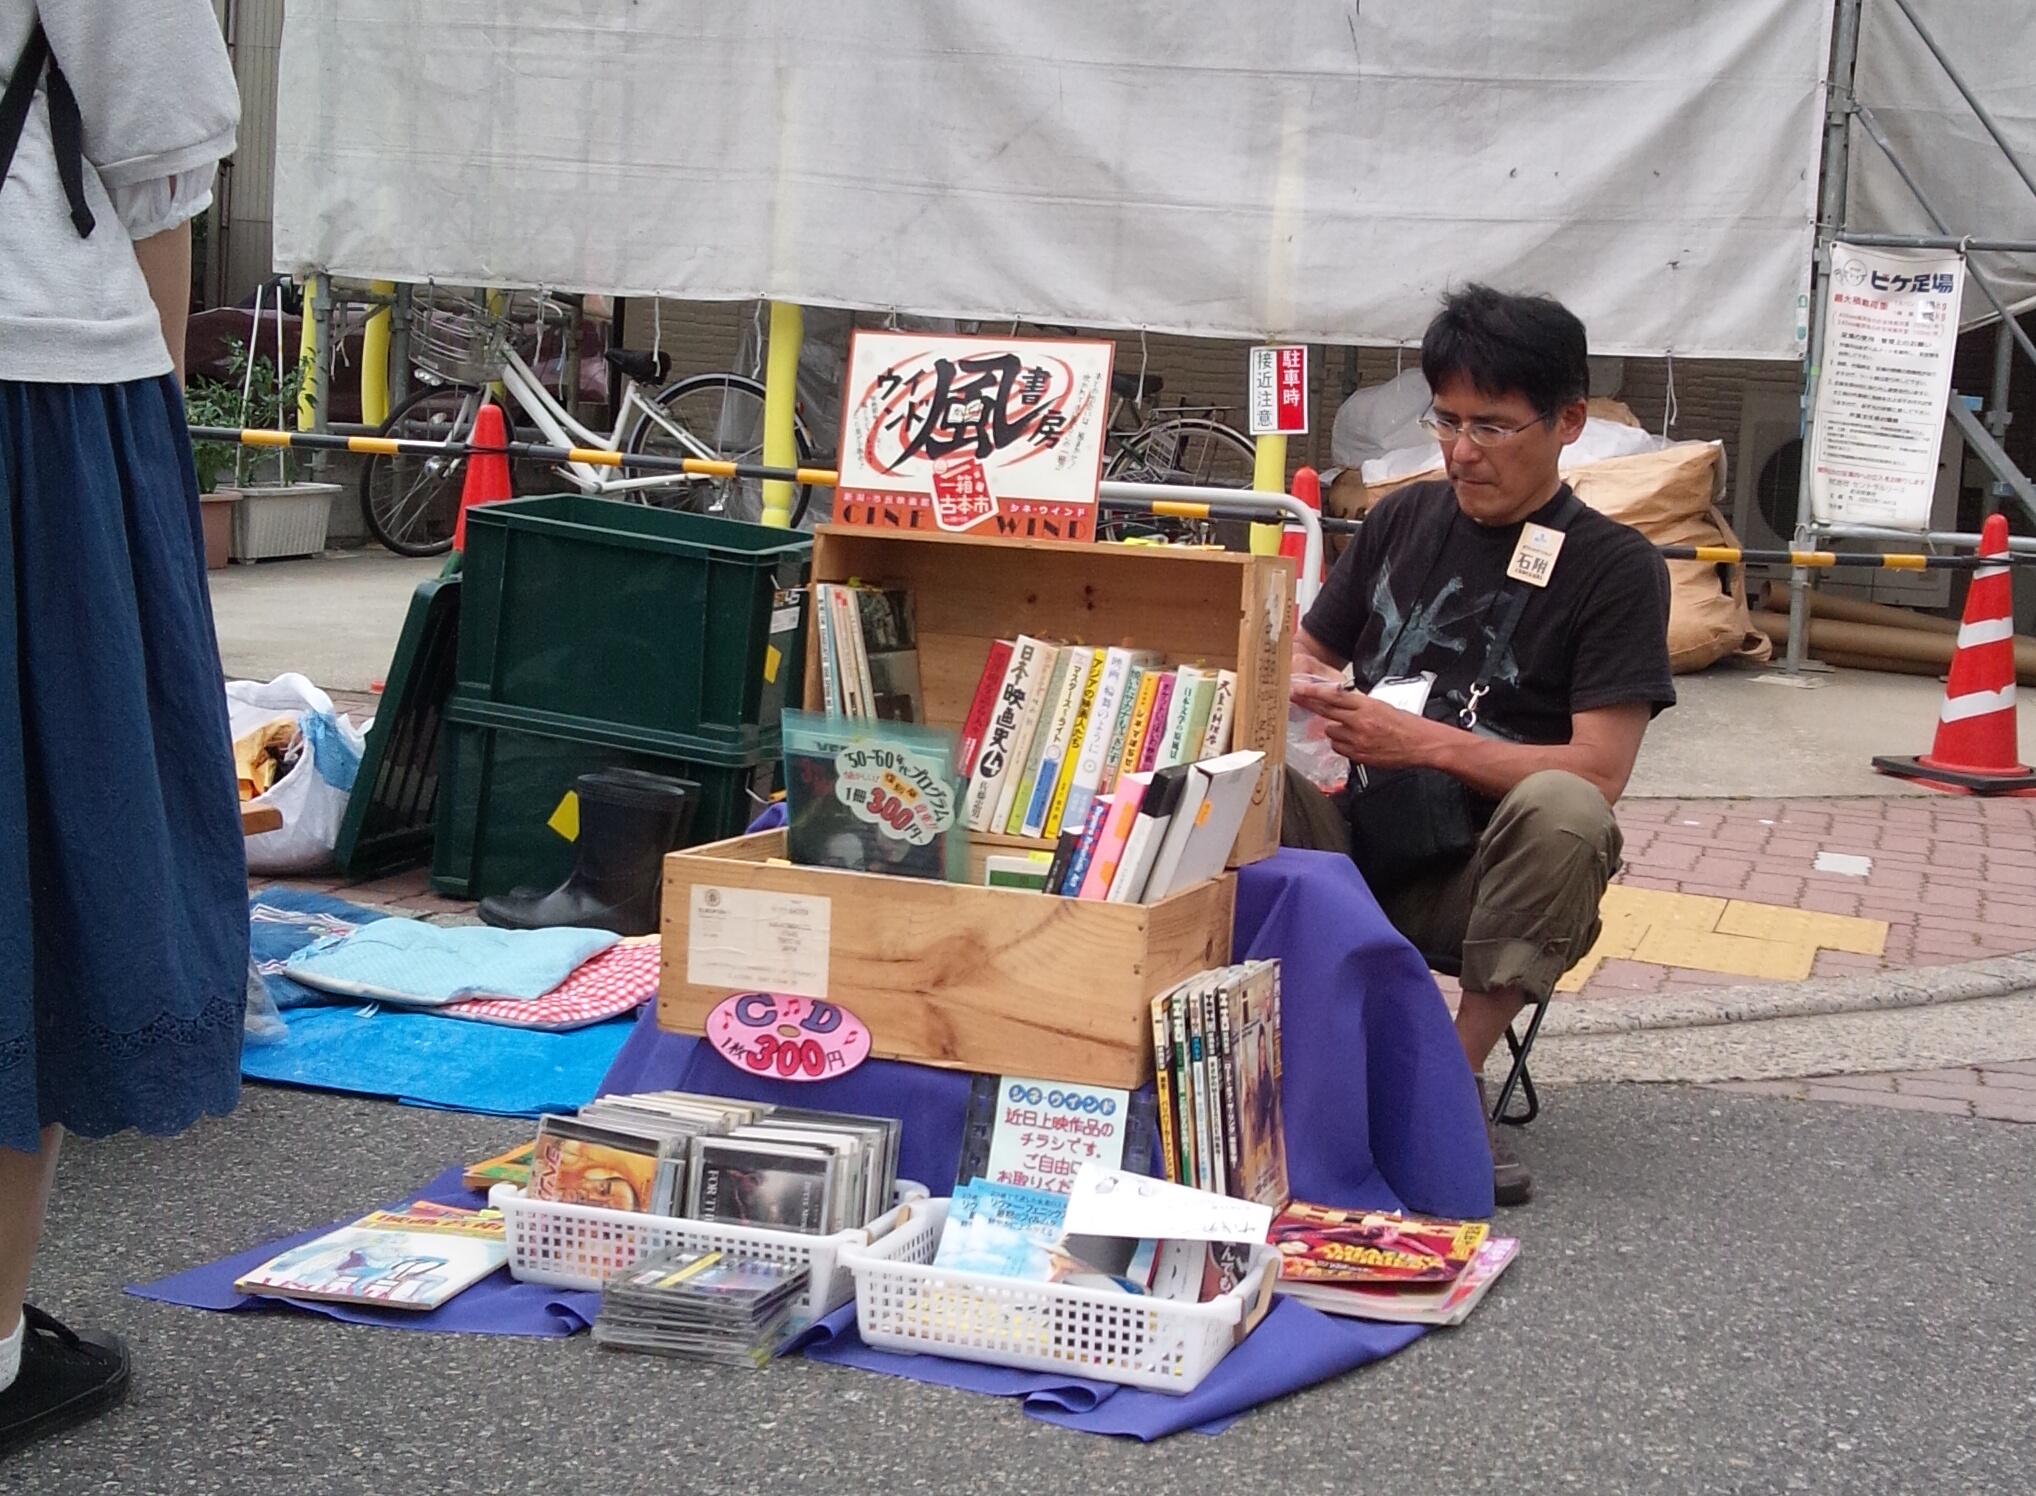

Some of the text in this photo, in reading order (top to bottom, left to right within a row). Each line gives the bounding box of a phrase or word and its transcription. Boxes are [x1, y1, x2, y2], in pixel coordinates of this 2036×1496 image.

[1871, 270, 1954, 293] ビケ足場
[1257, 352, 1272, 427] 接近注意
[1282, 349, 1301, 407] 駐車時
[881, 353, 1063, 475] 風
[1021, 366, 1067, 449] 書房
[843, 504, 1087, 540] CINE WIND
[940, 494, 989, 515] 古本市
[1010, 503, 1085, 517] シネ・ウインド
[968, 780, 988, 818] 佐藤忠男
[736, 993, 843, 1034] CD
[1005, 1107, 1114, 1137] 近日上映作品の
[1021, 1132, 1102, 1159] チラシです。
